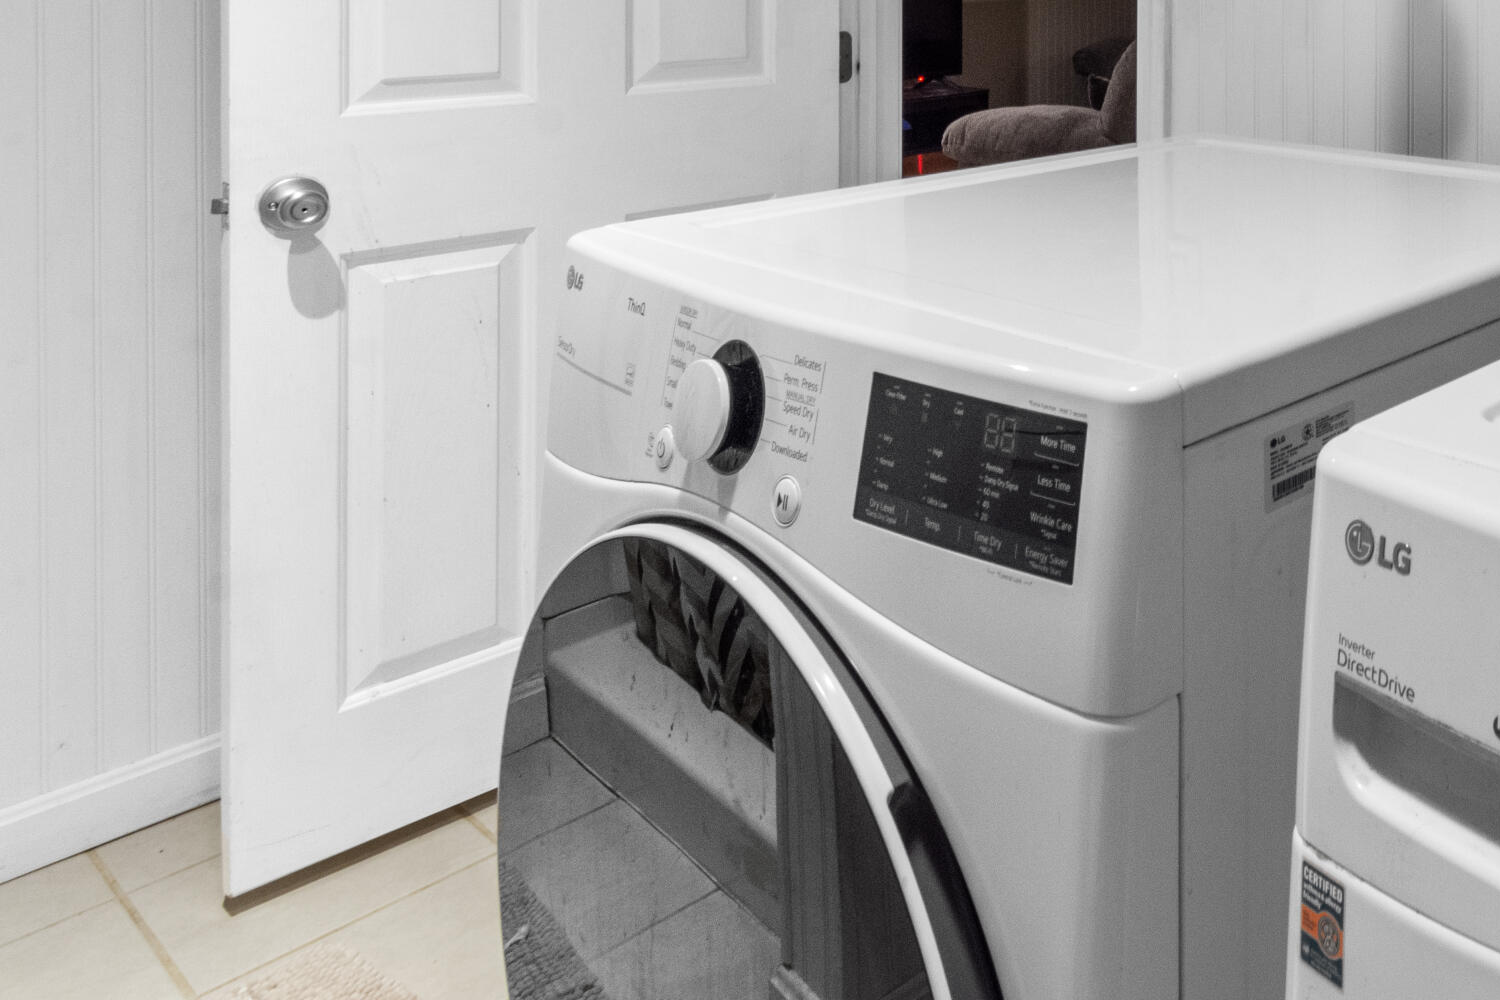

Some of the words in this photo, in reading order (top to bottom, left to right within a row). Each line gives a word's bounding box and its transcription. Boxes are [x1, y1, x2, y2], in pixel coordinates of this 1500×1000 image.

[628, 297, 646, 316] ThinQ
[794, 354, 822, 372] Delicates
[802, 378, 819, 393] Press
[783, 401, 801, 417] Speed
[803, 407, 814, 422] Dry
[788, 424, 798, 437] Air
[799, 427, 811, 443] Dry
[771, 441, 809, 463] Downloaded
[1041, 435, 1058, 449] More
[1060, 439, 1076, 454] Time
[1037, 474, 1053, 488] Less
[1054, 478, 1071, 493] Time
[869, 498, 879, 512] Dry
[1030, 511, 1055, 527] Wrinkle
[1056, 518, 1072, 533] Care
[990, 535, 1002, 551] Dry
[1024, 545, 1048, 562] Energy
[1338, 632, 1376, 661] Inverter
[1303, 865, 1343, 903] CERTIFIED
